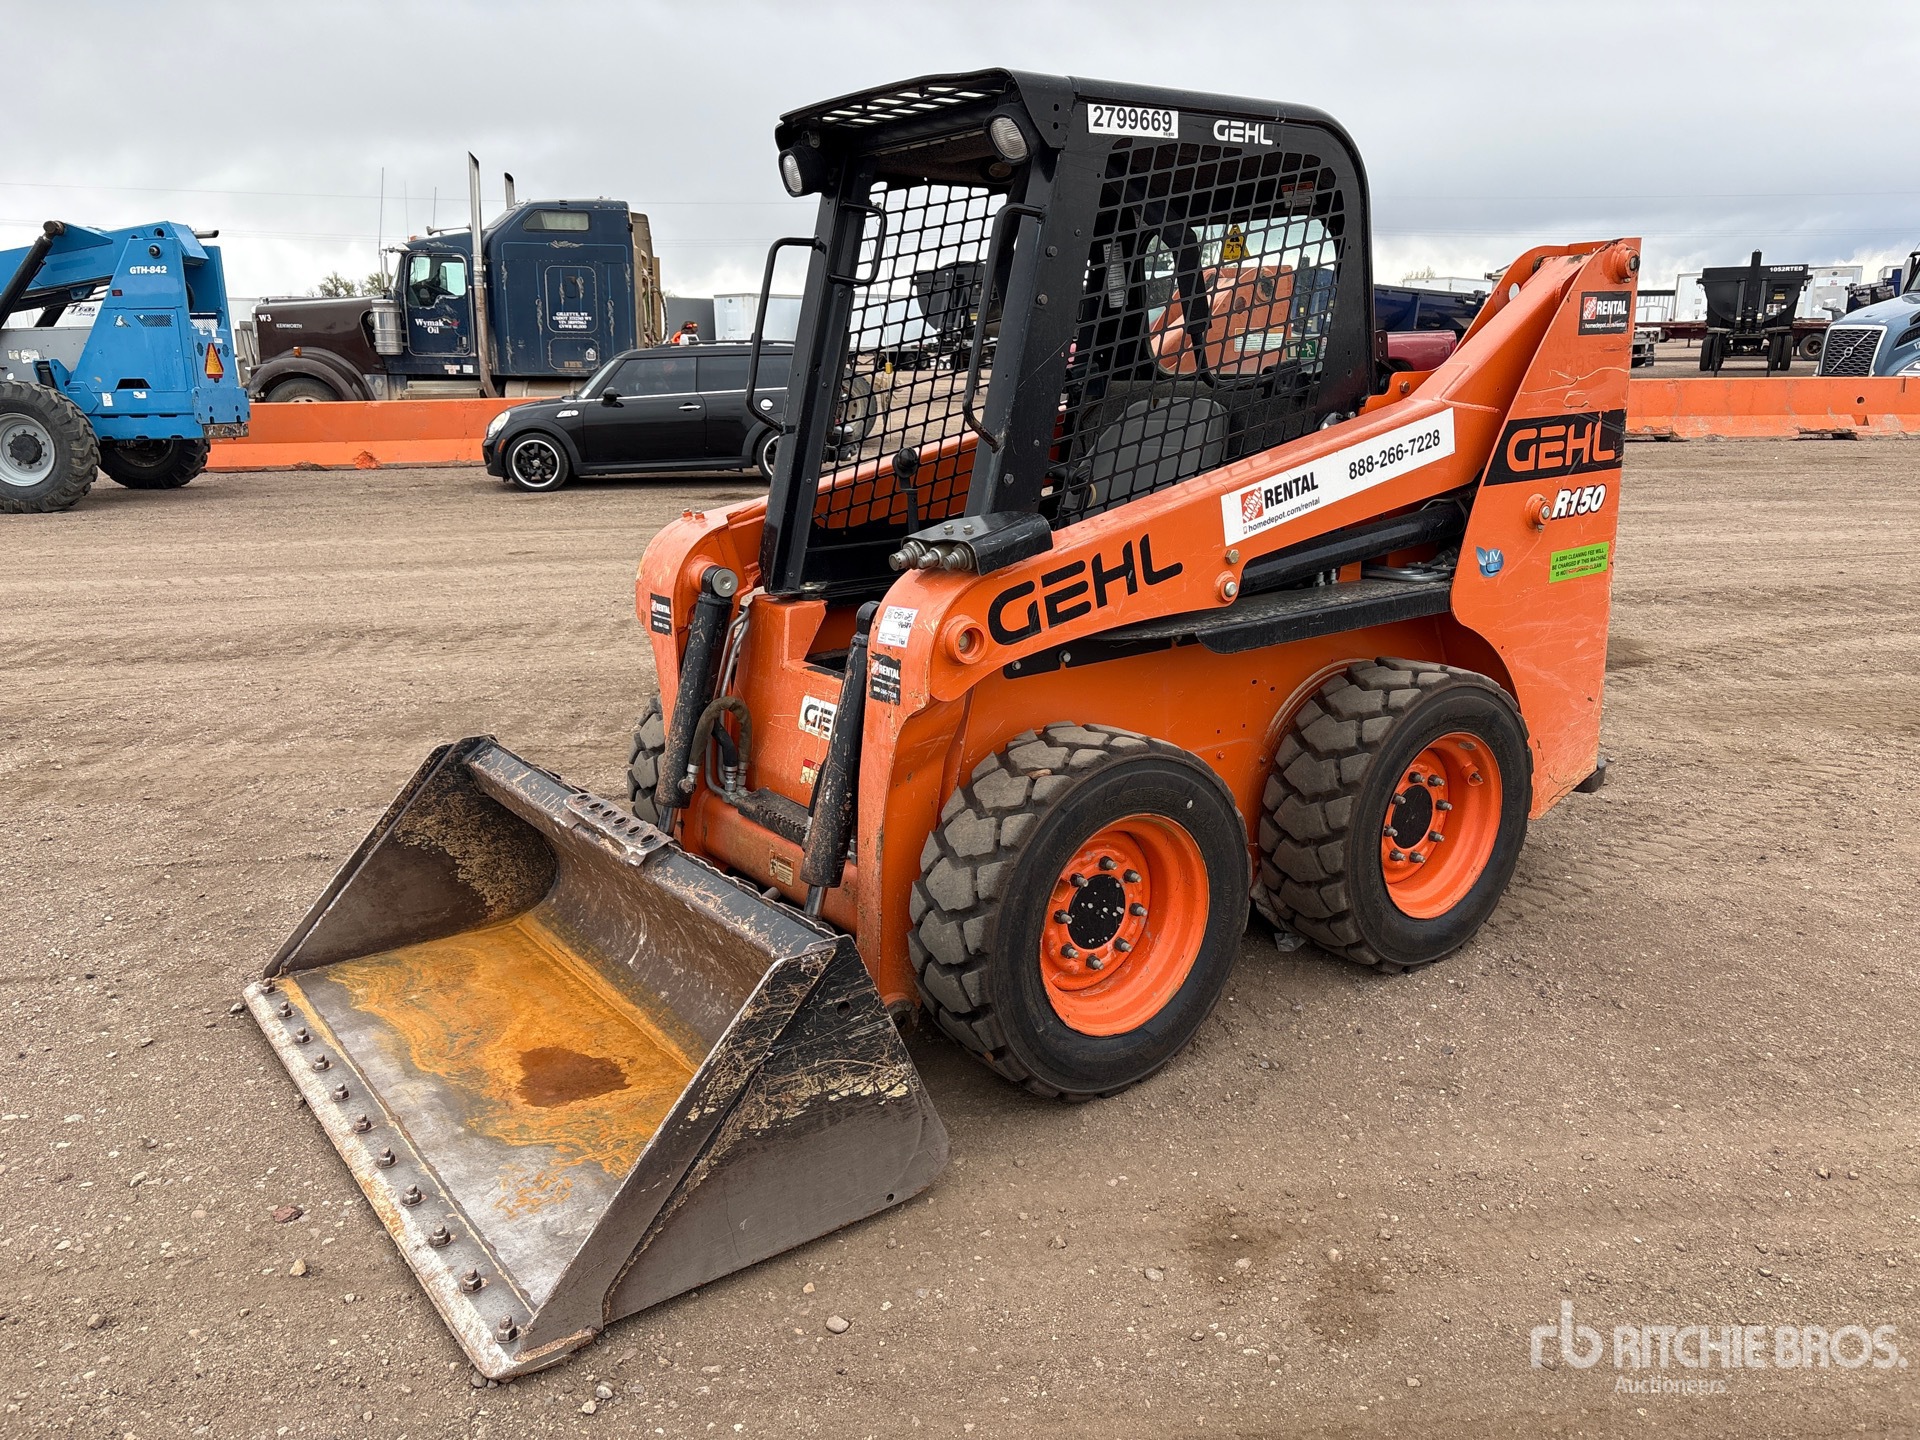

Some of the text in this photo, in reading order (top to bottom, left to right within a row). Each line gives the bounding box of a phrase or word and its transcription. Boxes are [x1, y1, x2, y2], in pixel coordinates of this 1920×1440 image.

[1092, 105, 1172, 132] 2799669
[1213, 119, 1273, 145] GEHL
[129, 265, 167, 274] GTH-842
[258, 314, 272, 322] W3
[1597, 301, 1627, 315] RENTAL
[415, 318, 444, 328] Wymak
[427, 326, 439, 334] Oil
[1348, 429, 1440, 480] 888-266-7228
[1507, 421, 1615, 472] GEHL
[1264, 471, 1319, 509] RENTAL
[1551, 484, 1606, 520] R150
[1248, 496, 1320, 532] homedepot.com/rental
[988, 533, 1184, 646] GEHL
[878, 664, 900, 679] RENTAL
